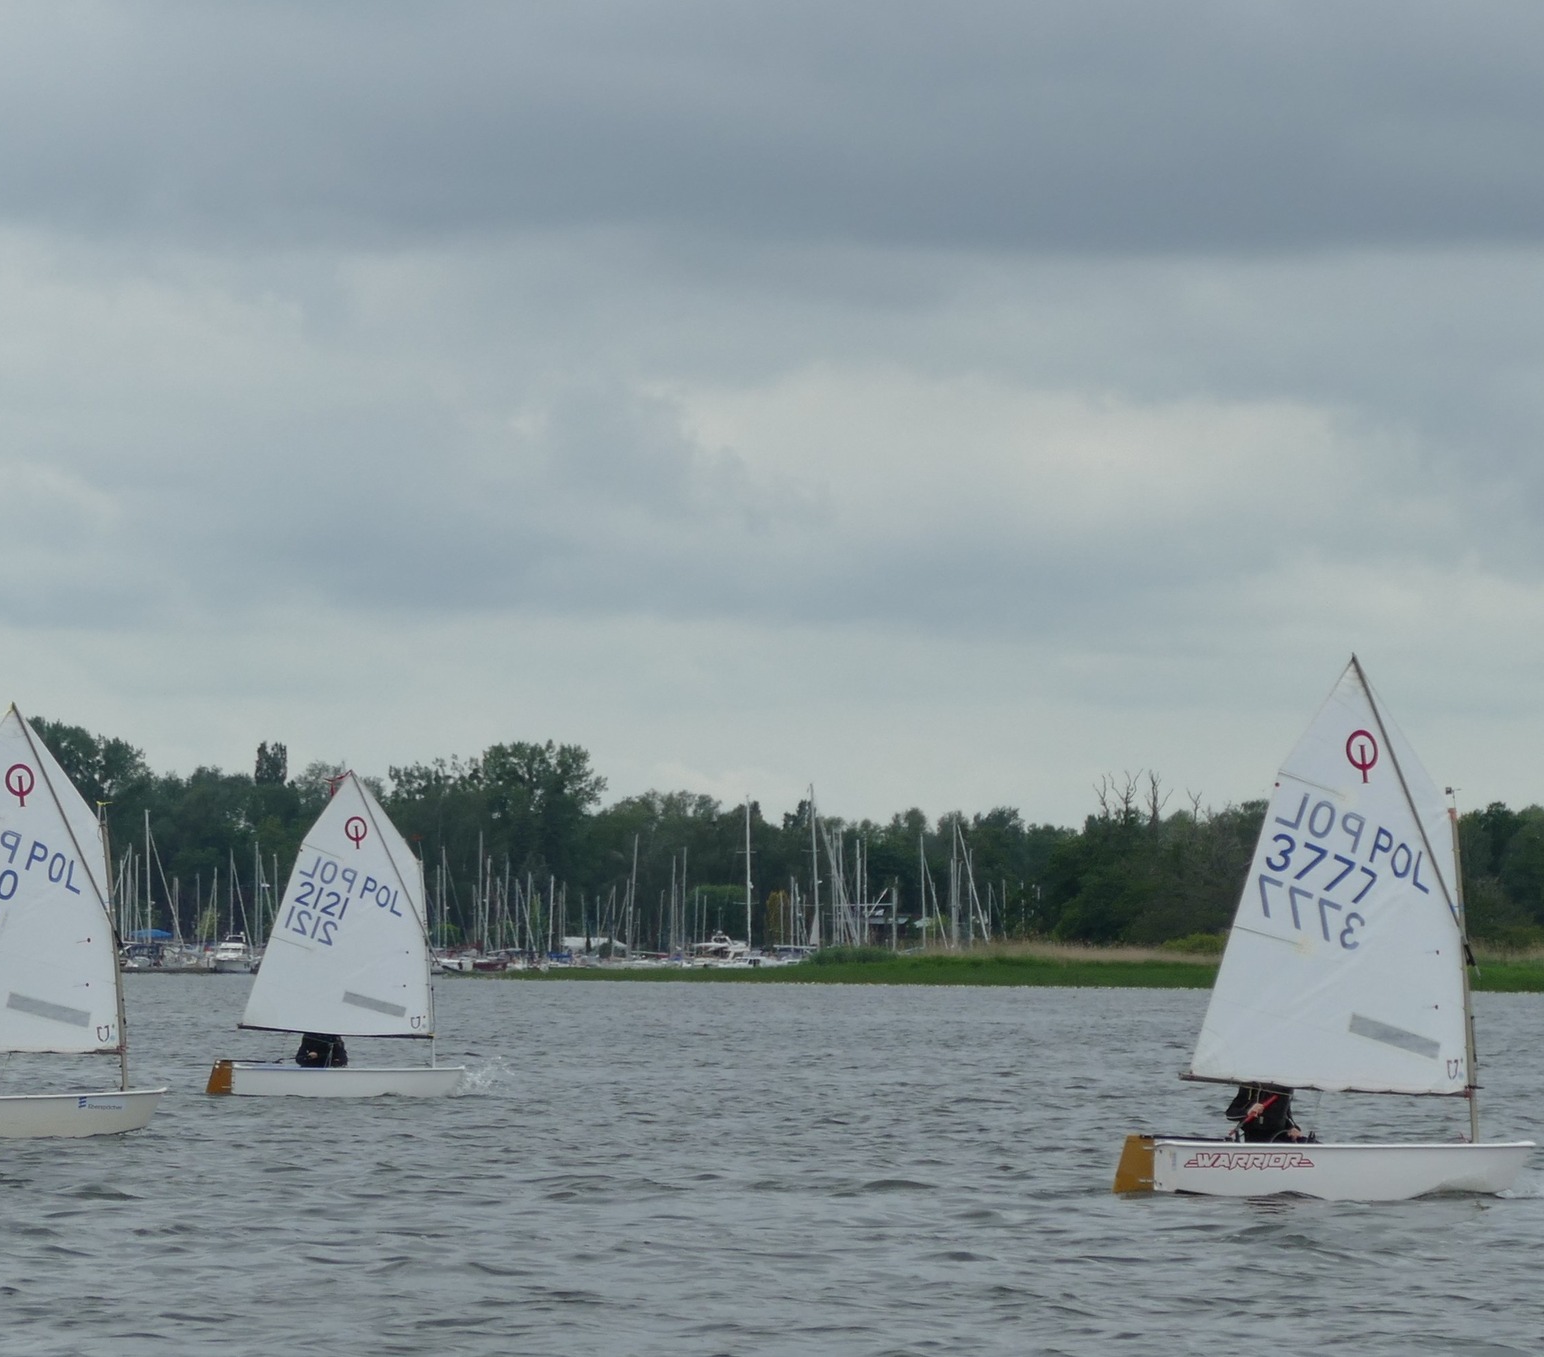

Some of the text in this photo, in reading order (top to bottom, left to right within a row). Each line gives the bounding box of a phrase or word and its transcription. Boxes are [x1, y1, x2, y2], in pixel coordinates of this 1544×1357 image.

[25, 840, 81, 895] POL
[1265, 833, 1378, 904] 3777
[1369, 826, 1429, 895] POL
[294, 881, 350, 920] 2121
[360, 876, 402, 917] POL
[1195, 1152, 1304, 1170] WARRIOR
